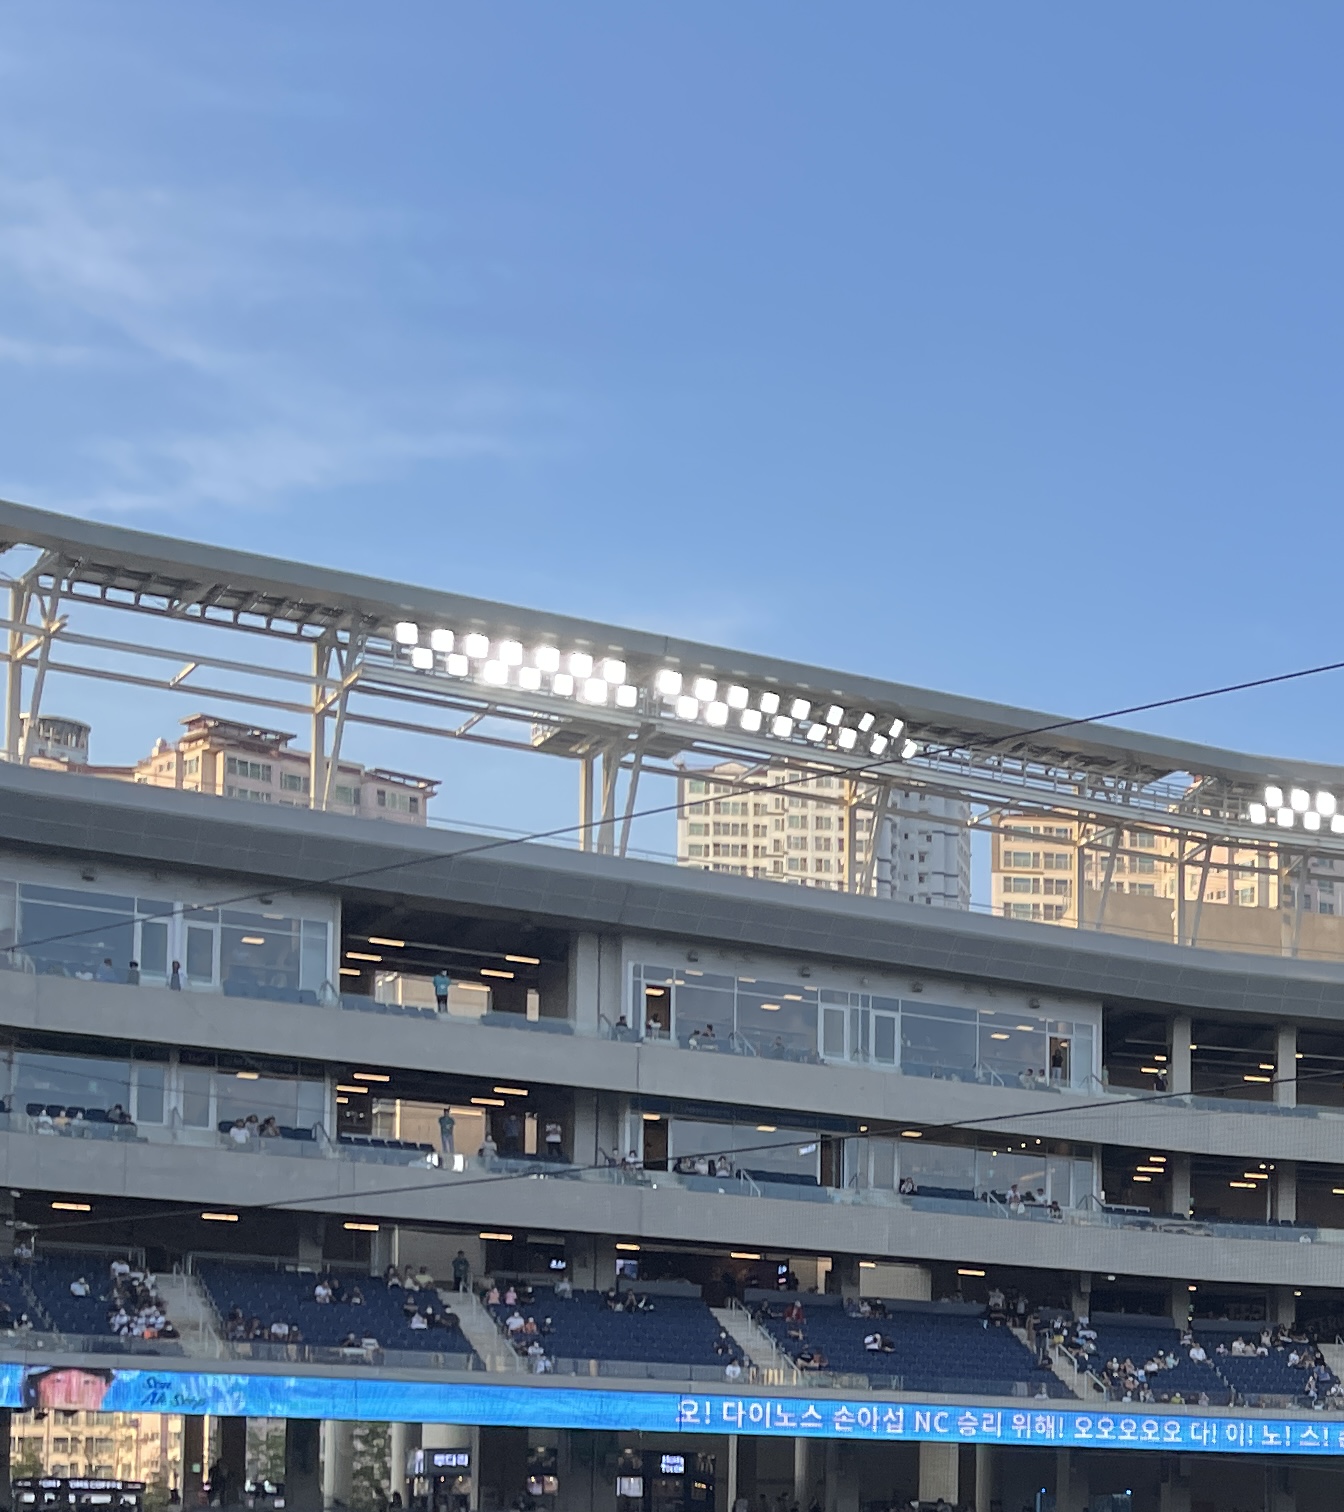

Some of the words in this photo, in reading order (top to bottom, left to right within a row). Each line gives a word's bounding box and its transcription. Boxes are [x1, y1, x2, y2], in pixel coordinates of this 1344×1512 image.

[676, 1400, 711, 1424] 오!
[722, 1401, 823, 1428] 다이노스
[833, 1405, 905, 1433] 손아섭
[914, 1411, 949, 1433] NC
[958, 1411, 1002, 1437] 승리
[1011, 1414, 1064, 1439] 위해!
[1074, 1416, 1183, 1442] 오오오오오
[1190, 1421, 1218, 1445] 다!
[1226, 1423, 1253, 1446] 이!
[1262, 1425, 1291, 1447] 노!
[1300, 1426, 1329, 1447] 스!
